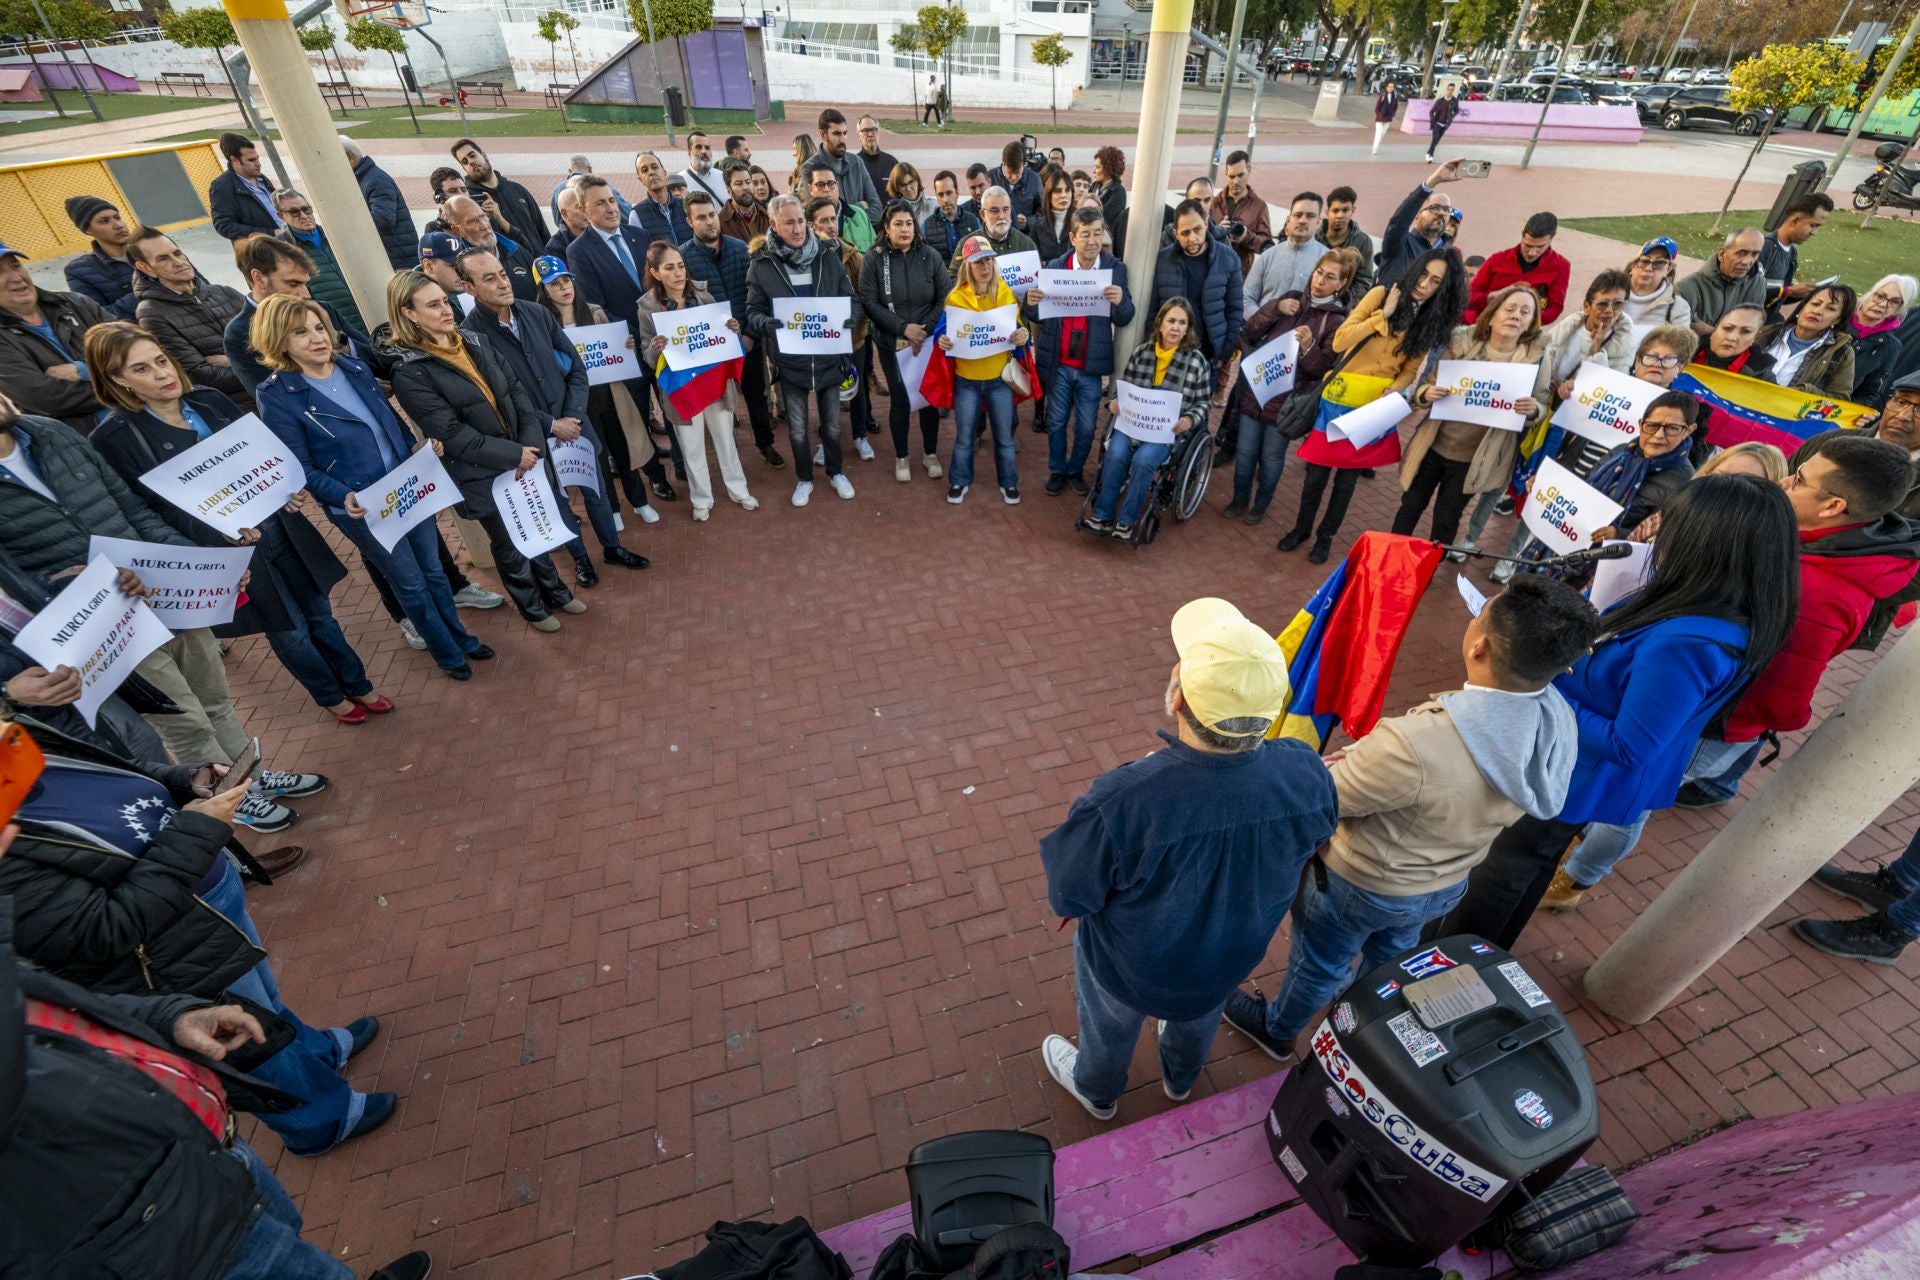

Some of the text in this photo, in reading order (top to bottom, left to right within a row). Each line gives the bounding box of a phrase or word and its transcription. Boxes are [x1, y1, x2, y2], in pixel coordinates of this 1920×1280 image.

[786, 320, 821, 331] bravo
[793, 312, 828, 323] Gloria
[963, 323, 995, 333] Gloria
[671, 332, 705, 345] bravo
[676, 322, 710, 336] Gloria
[802, 328, 841, 340] pueblo
[956, 329, 989, 339] bravo
[688, 335, 726, 353] pueblo
[970, 335, 1006, 347] pueblo
[585, 354, 624, 370] pueblo
[1255, 352, 1286, 374] Gloria
[1252, 363, 1282, 385] bravo
[1460, 377, 1501, 391] Gloria
[1449, 385, 1490, 398] bravo
[1593, 386, 1632, 411] Gloria
[1464, 398, 1513, 411] pueblo
[1578, 392, 1617, 416] bravo
[1588, 409, 1636, 434] pueblo
[177, 440, 250, 484] MURCIA GRITA
[197, 455, 285, 515] ¡LIBERTAD PARA
[216, 471, 285, 517] VENEZUELA!
[385, 475, 419, 505] Gloria
[520, 478, 530, 497] PAR
[380, 489, 414, 519] bravo
[398, 482, 436, 518] pueblo
[1535, 489, 1565, 519] bravo
[1547, 486, 1578, 516] Gloria
[504, 487, 528, 542] MURCIA GRITA
[1541, 509, 1578, 542] pueblo
[130, 558, 226, 571] MURCIA GRITA
[198, 587, 231, 597] PARA
[51, 588, 111, 647] MURCIA GRITA
[80, 607, 137, 676] IBERTAD PARA
[84, 626, 136, 688] VENEZUELA!
[1314, 1030, 1491, 1198] #SosCuba
